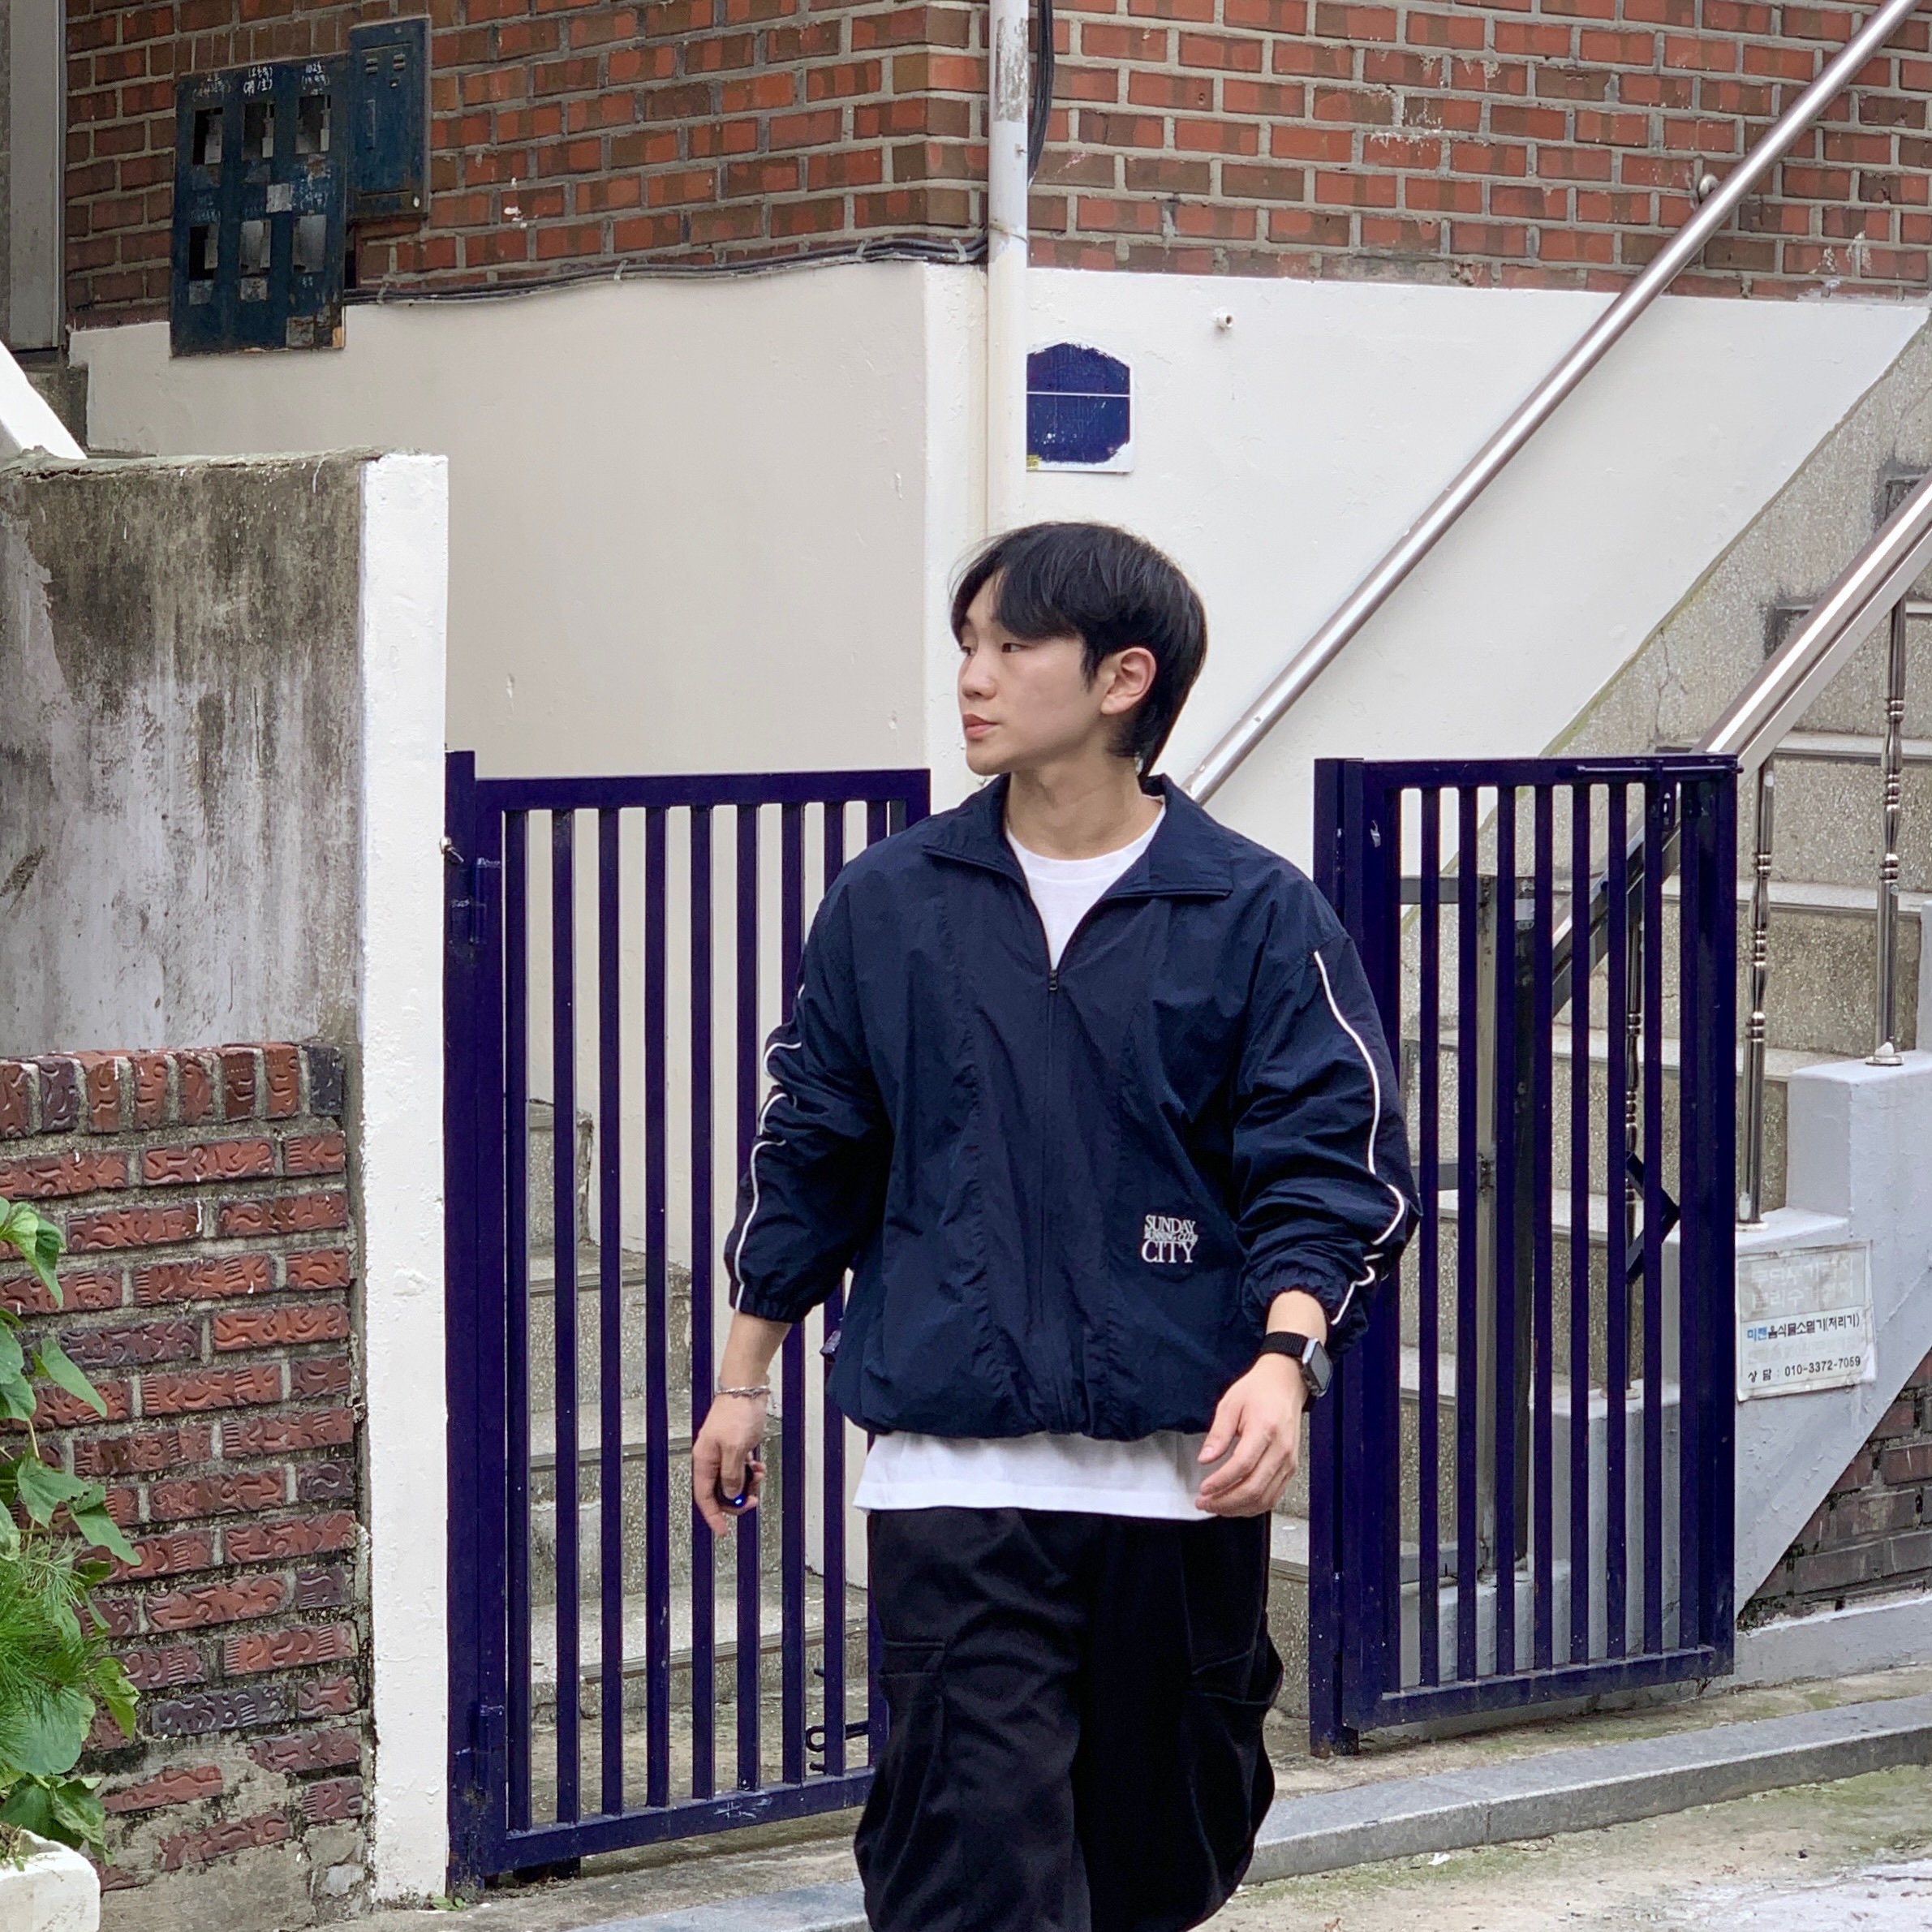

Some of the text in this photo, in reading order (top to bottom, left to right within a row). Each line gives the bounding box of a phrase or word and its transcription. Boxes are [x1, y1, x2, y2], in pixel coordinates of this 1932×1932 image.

[1144, 1214, 1196, 1234] SUNDAY
[1141, 1239, 1196, 1263] CITY
[1784, 1355, 1861, 1377] 010-3372-7059
